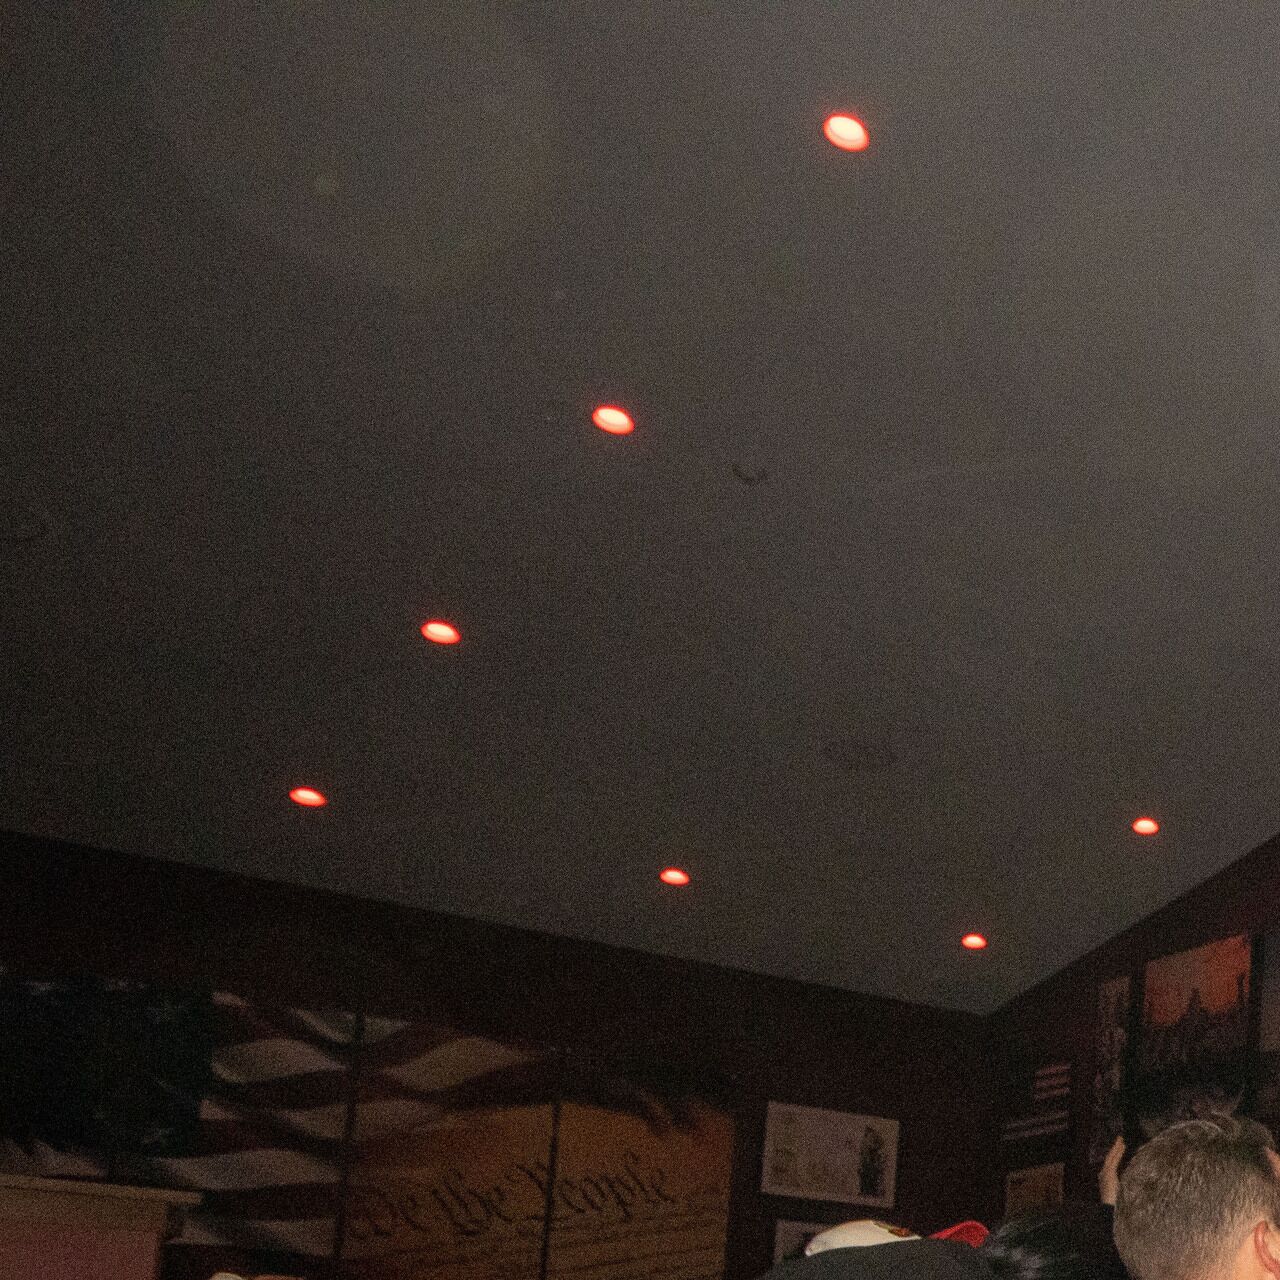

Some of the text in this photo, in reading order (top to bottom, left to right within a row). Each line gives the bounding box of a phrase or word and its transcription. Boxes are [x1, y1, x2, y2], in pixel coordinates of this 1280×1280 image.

[347, 1151, 677, 1241] We the People
